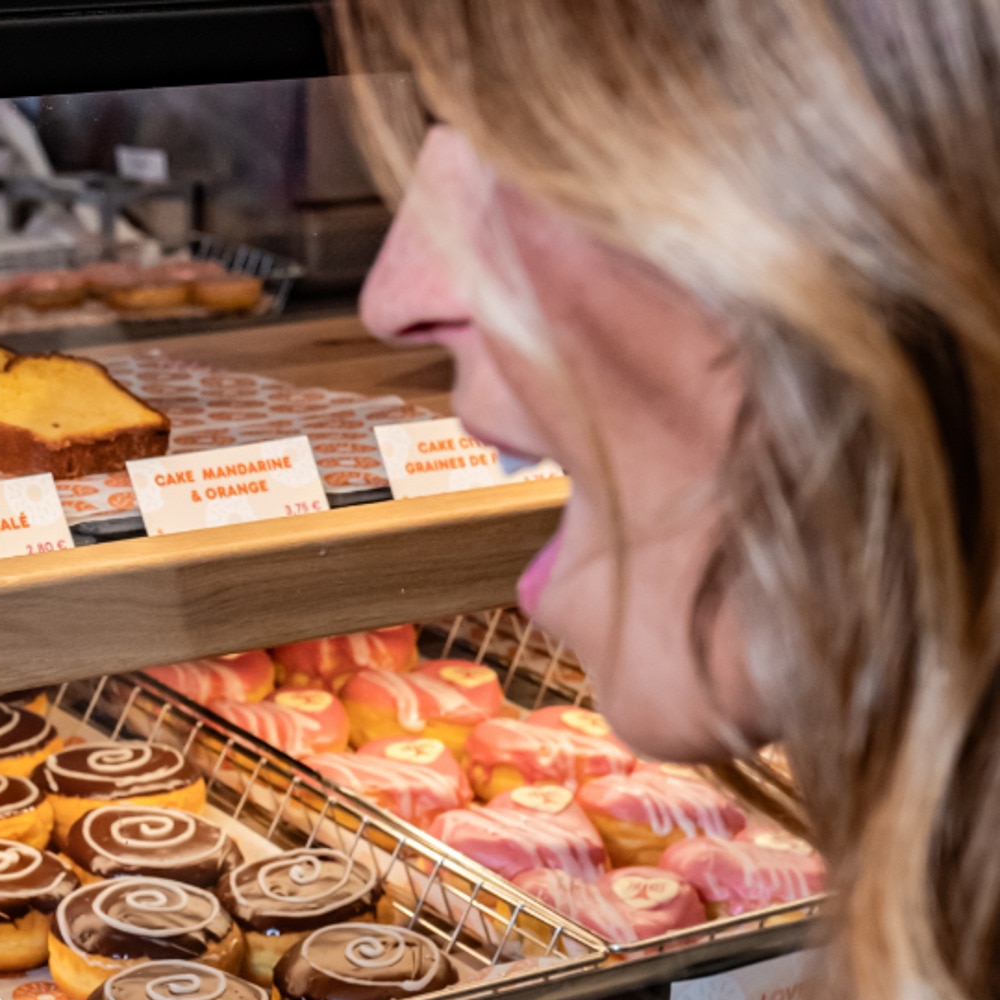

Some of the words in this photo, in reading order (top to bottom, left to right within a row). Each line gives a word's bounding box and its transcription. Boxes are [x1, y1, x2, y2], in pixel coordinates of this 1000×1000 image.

[417, 438, 455, 454] CAKE
[154, 469, 195, 487] CAKE
[202, 456, 293, 481] MANDARINE
[405, 457, 466, 475] GRAINES
[469, 454, 488, 467] DE
[190, 489, 203, 503] &
[205, 480, 269, 500] ORANGE
